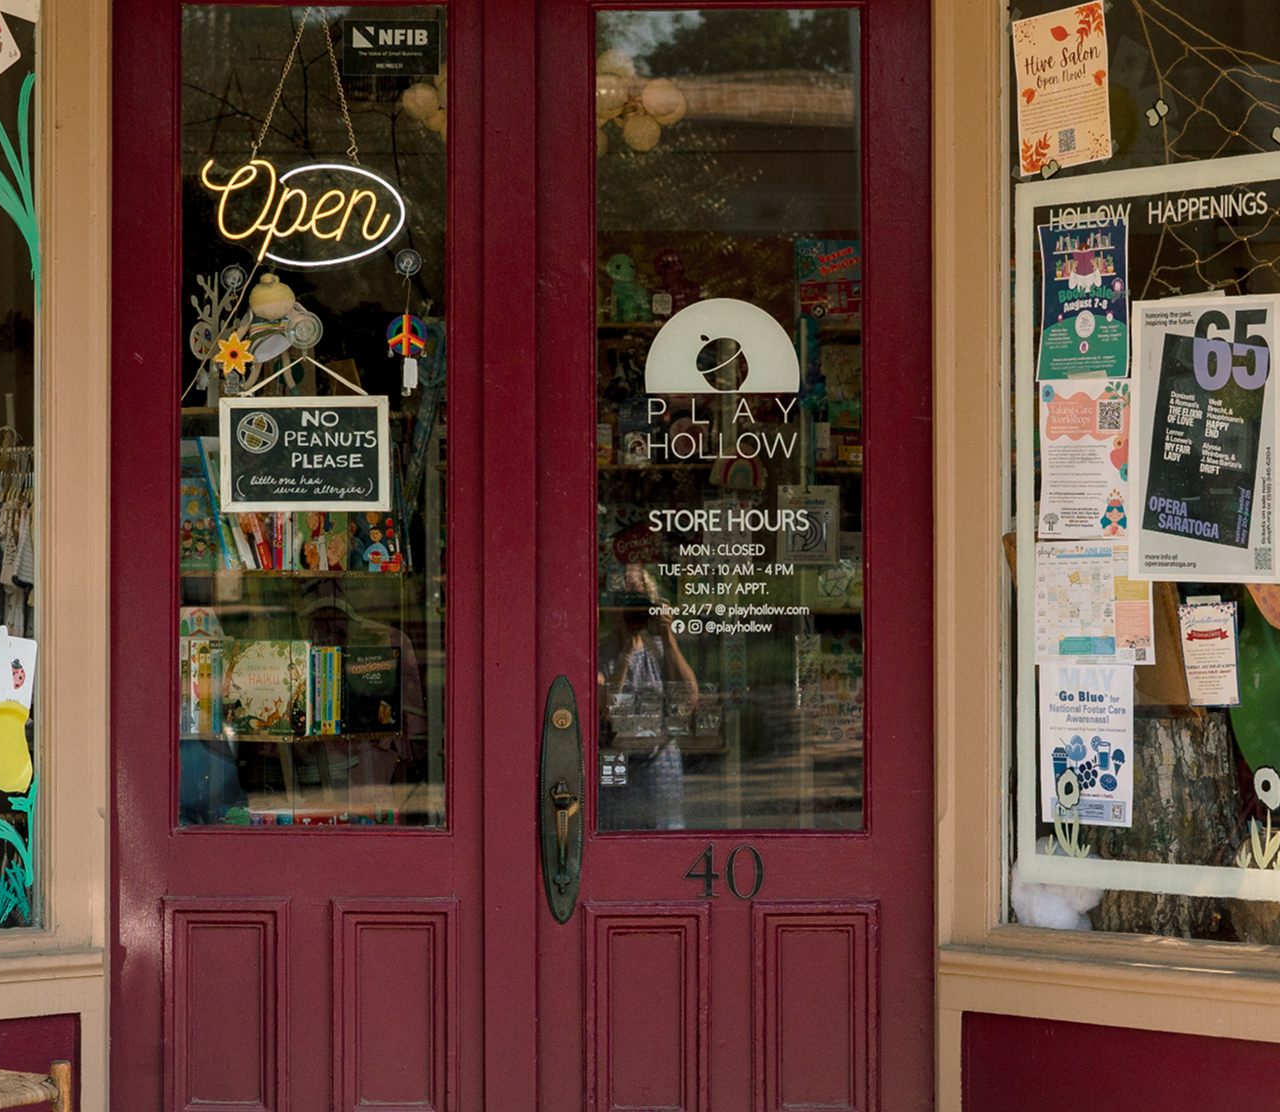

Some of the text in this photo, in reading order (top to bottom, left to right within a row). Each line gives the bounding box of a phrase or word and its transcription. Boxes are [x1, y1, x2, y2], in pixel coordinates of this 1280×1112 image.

[378, 29, 428, 46] NFIB
[1024, 42, 1101, 76] Hive Salon
[1037, 63, 1086, 90] Open Now!
[201, 159, 391, 262] Open
[1049, 191, 1269, 231] HOLLOW HAPPENINGS
[818, 247, 853, 264] Rescue
[1058, 285, 1112, 304] Book Sale
[1063, 298, 1108, 313] August 7-8
[1192, 309, 1270, 391] 65
[1170, 391, 1195, 401] Donizetti
[647, 397, 797, 424] PLAY
[1050, 405, 1092, 417] Taking Care
[1168, 405, 1202, 420] THE ELIXIR
[1206, 412, 1244, 424] Hauptmann's
[301, 410, 339, 428] NO
[1167, 414, 1194, 427] OF LOVE
[1206, 420, 1230, 432] HAPPY
[284, 430, 377, 448] PEANUTS
[1205, 429, 1220, 438] END
[647, 432, 797, 459] HOLLOW
[1164, 442, 1191, 455] MY FAIR
[1202, 442, 1222, 452] Alyssa
[291, 452, 364, 468] PLEASE
[1164, 450, 1182, 462] LADY
[1200, 463, 1220, 475] DRIFT
[250, 474, 323, 486] little one has
[1148, 495, 1188, 518] OPERA
[648, 509, 810, 532] STORE HOURS
[1262, 510, 1266, 520] on
[1158, 514, 1220, 539] SARATOGA
[1234, 514, 1243, 543] summer
[717, 544, 766, 556] CLOSED
[718, 564, 730, 576] 10
[732, 564, 754, 576] AM
[764, 564, 772, 576] 4
[774, 564, 794, 576] PM
[1144, 560, 1196, 568] operasaratoga.org
[717, 582, 732, 595] BY
[734, 582, 770, 595] APPT.
[648, 604, 810, 619] online 24/7 @ playhollow.com
[705, 620, 772, 636] @playhollow
[351, 661, 391, 674] canciones
[248, 673, 280, 685] HAIKU
[1058, 668, 1116, 692] MAY
[1110, 694, 1120, 703] for
[1049, 703, 1126, 715] National Foster Care
[1066, 714, 1110, 724] Awareness!
[684, 843, 764, 900] 40
